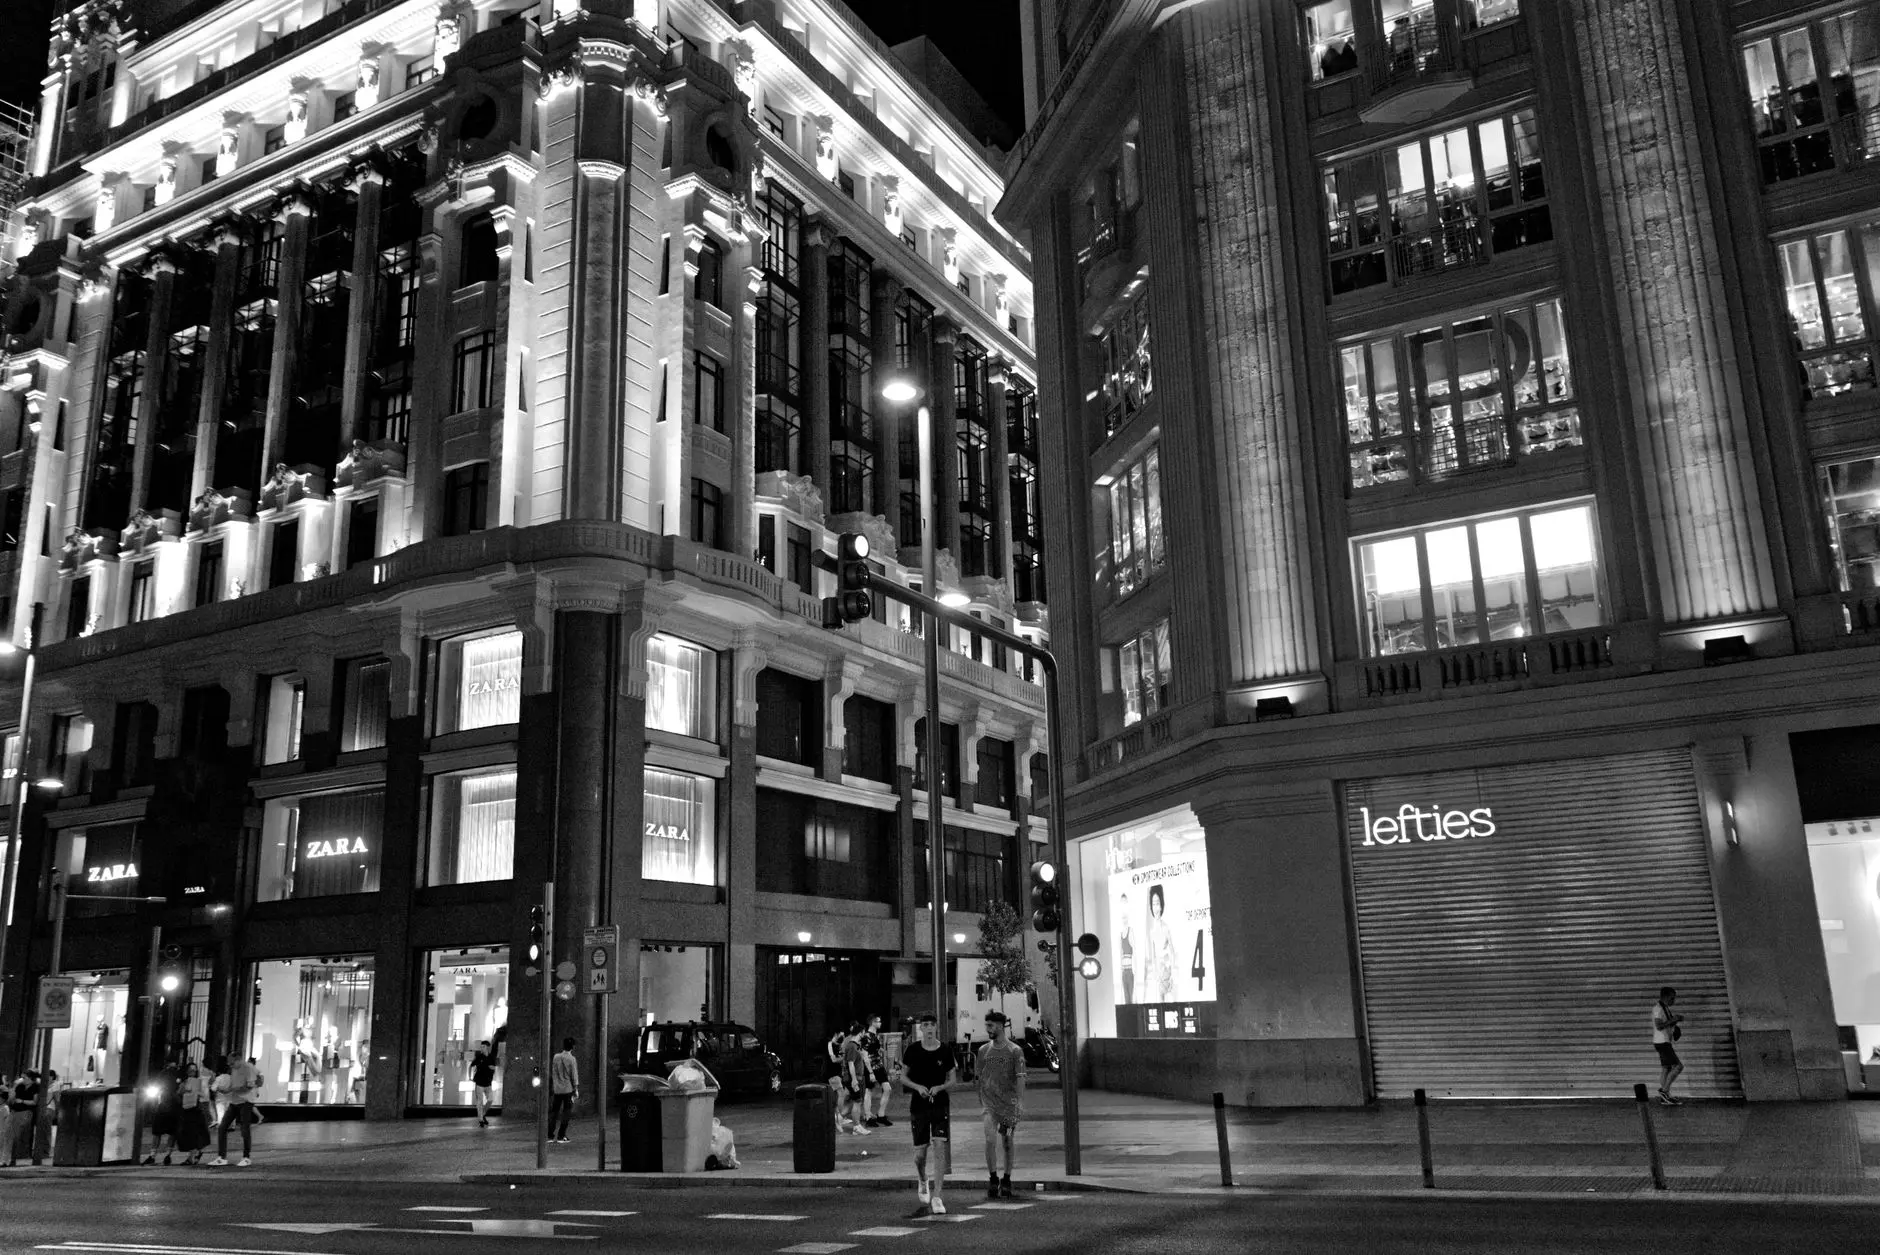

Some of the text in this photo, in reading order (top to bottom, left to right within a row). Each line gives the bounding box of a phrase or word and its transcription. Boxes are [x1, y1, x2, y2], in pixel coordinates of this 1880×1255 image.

[469, 677, 520, 695] ZARA
[645, 822, 690, 841] ZARA
[1359, 803, 1496, 846] lefties
[306, 836, 369, 858] ZARA
[88, 863, 139, 881] ZARA
[1192, 929, 1206, 991] 4
